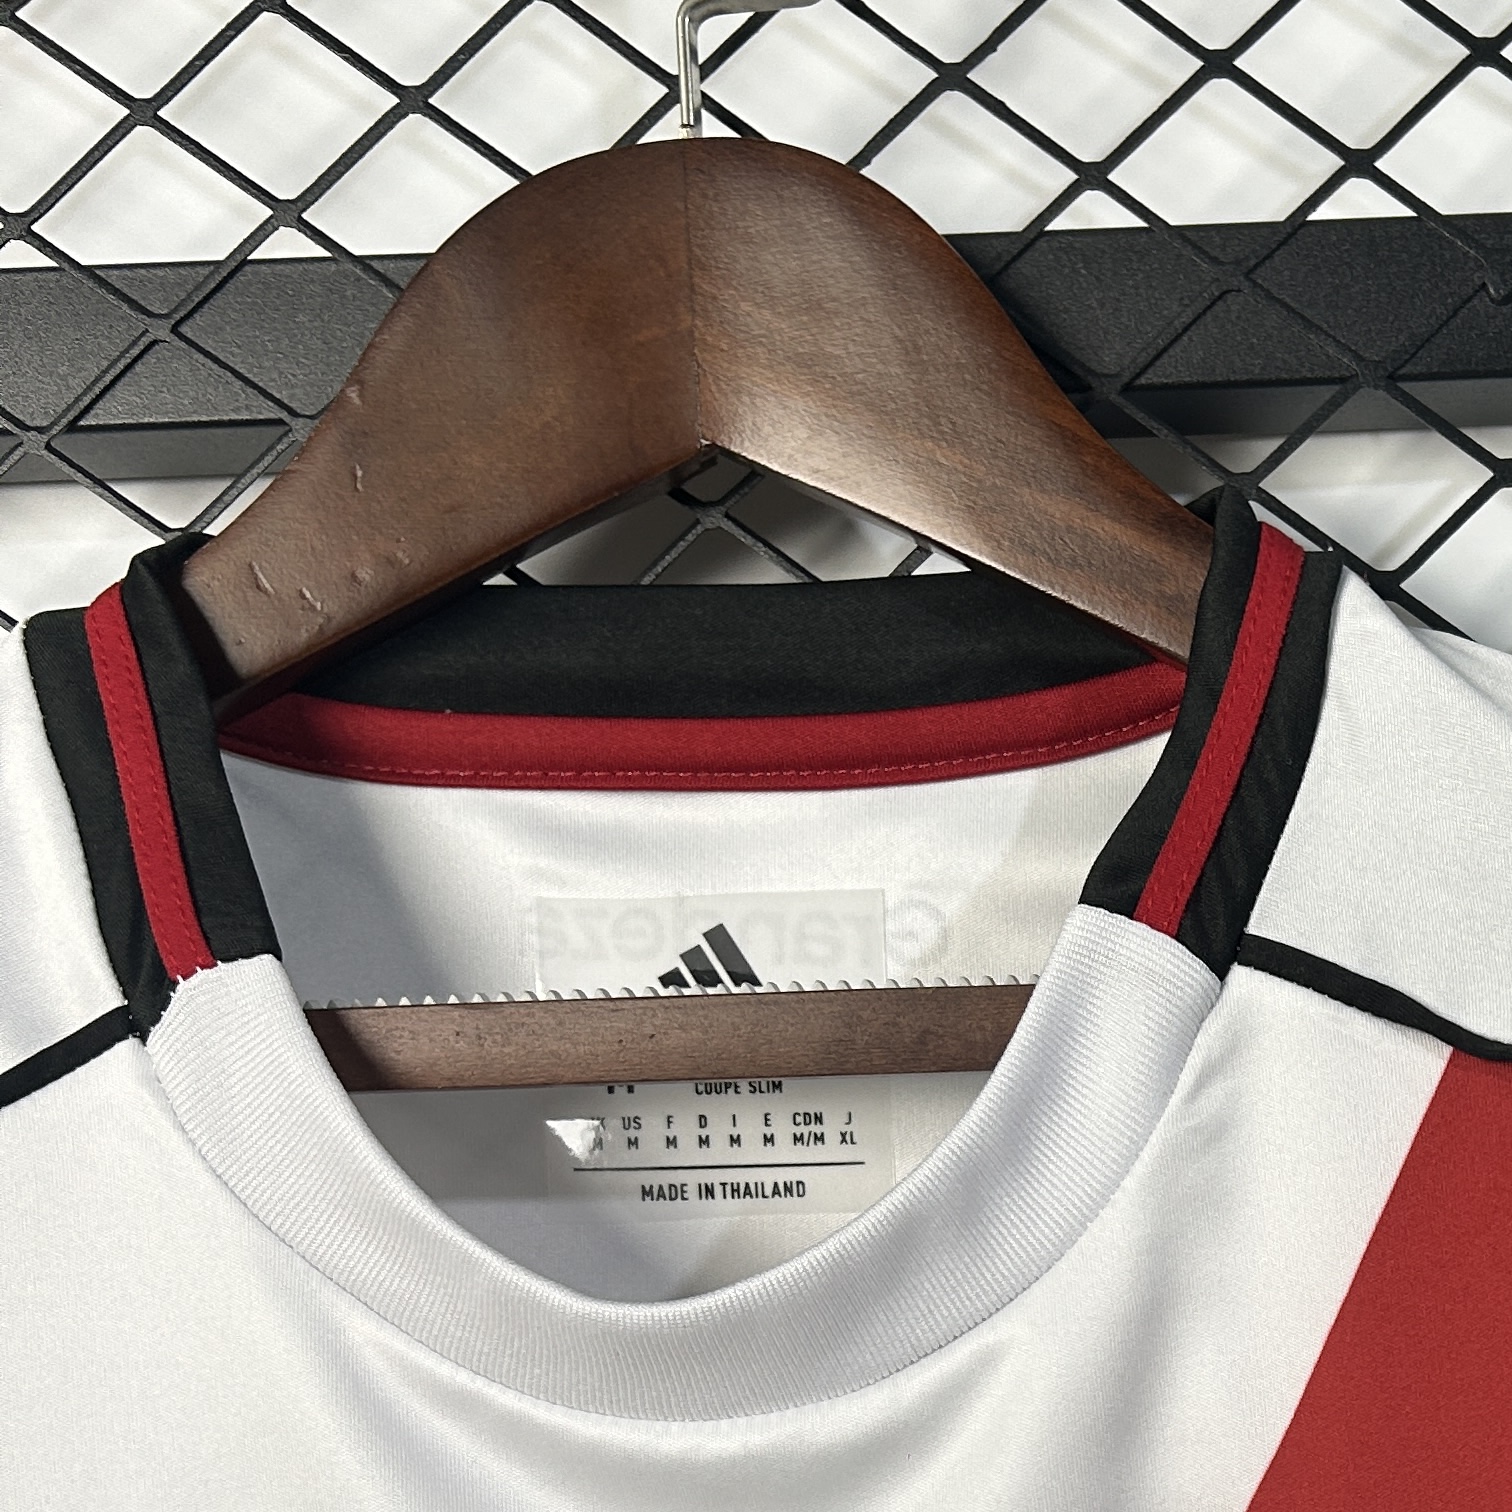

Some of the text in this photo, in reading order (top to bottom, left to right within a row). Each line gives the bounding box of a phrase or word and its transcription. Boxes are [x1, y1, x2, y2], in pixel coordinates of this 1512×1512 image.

[694, 1080, 783, 1096] COUPE SLIM
[622, 1116, 642, 1131] US
[667, 1115, 674, 1130] F
[698, 1114, 708, 1129] D
[764, 1112, 772, 1128] E
[792, 1111, 824, 1127] CDN
[844, 1111, 852, 1126] J
[627, 1136, 639, 1150] M
[666, 1135, 678, 1149] M
[698, 1134, 710, 1149] M
[729, 1134, 742, 1148] M
[763, 1133, 775, 1147] M
[793, 1131, 826, 1147] M/M
[839, 1130, 857, 1145] XL
[641, 1180, 807, 1202] MADE IN THAILAND
